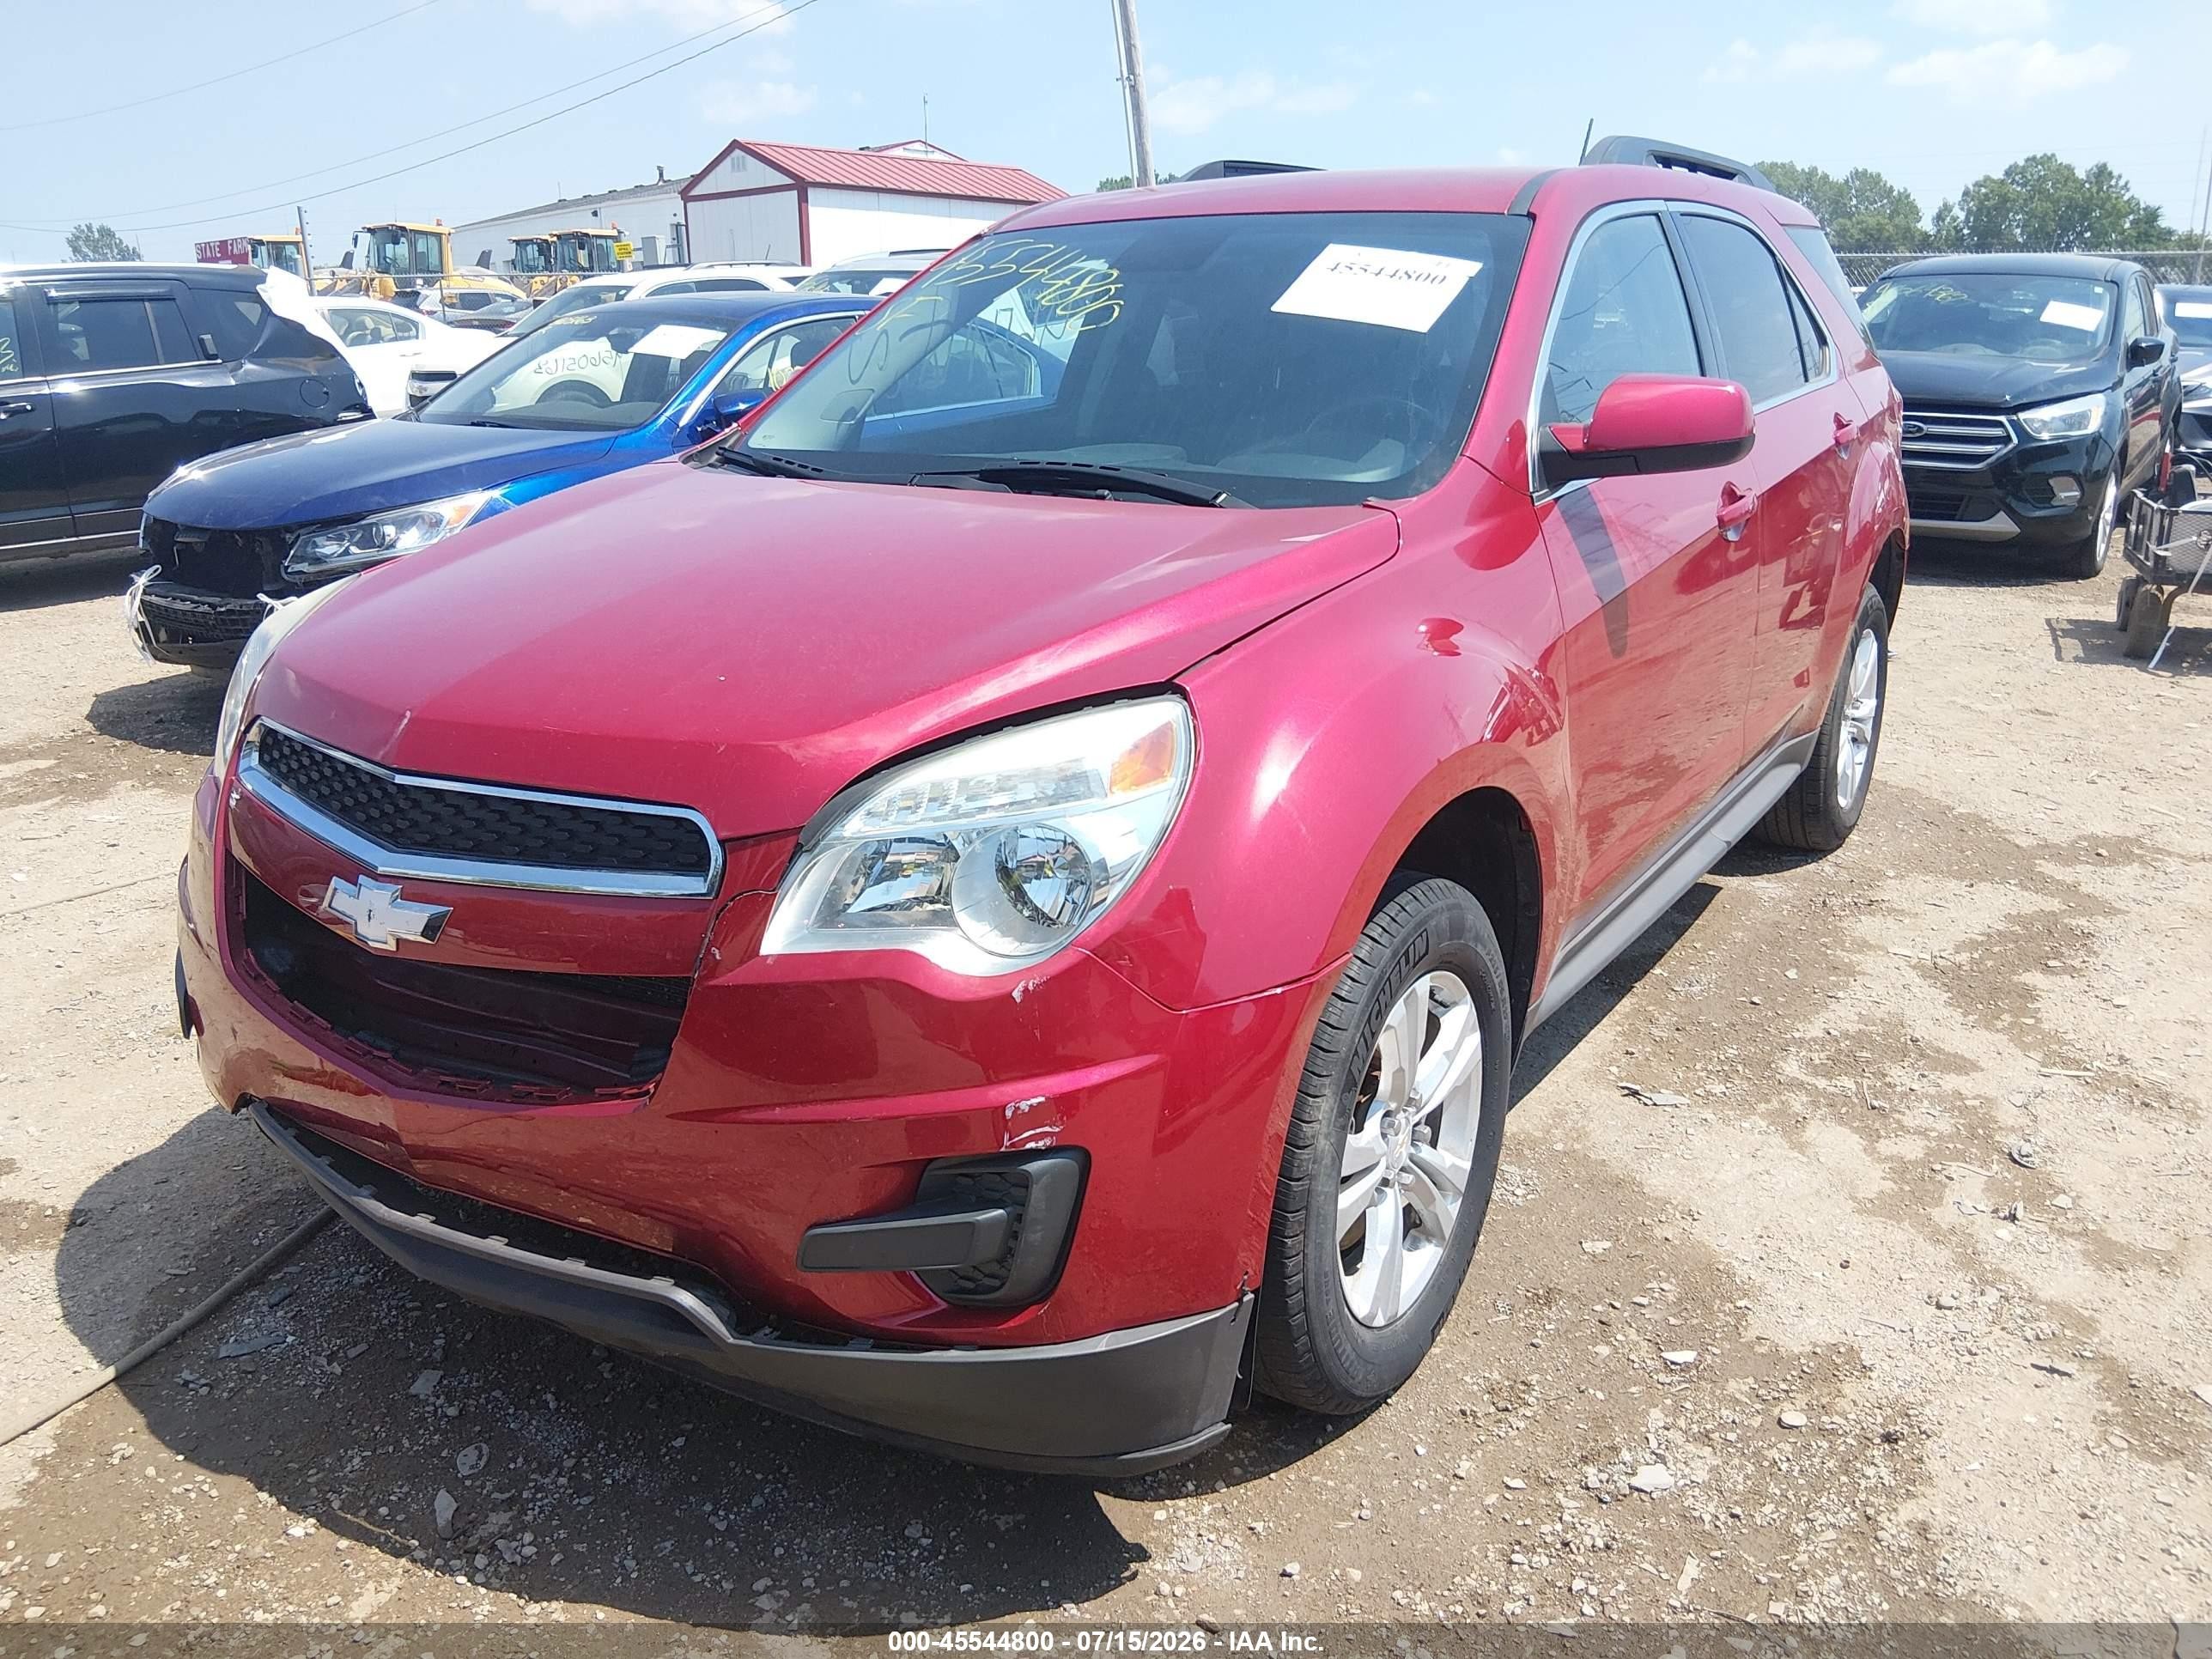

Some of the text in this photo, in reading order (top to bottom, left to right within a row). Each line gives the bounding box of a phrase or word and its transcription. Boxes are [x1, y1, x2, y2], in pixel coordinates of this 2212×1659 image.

[196, 242, 222, 259] STATE
[1327, 261, 1447, 284] 45544800
[1349, 928, 1429, 1082] MICHELIN
